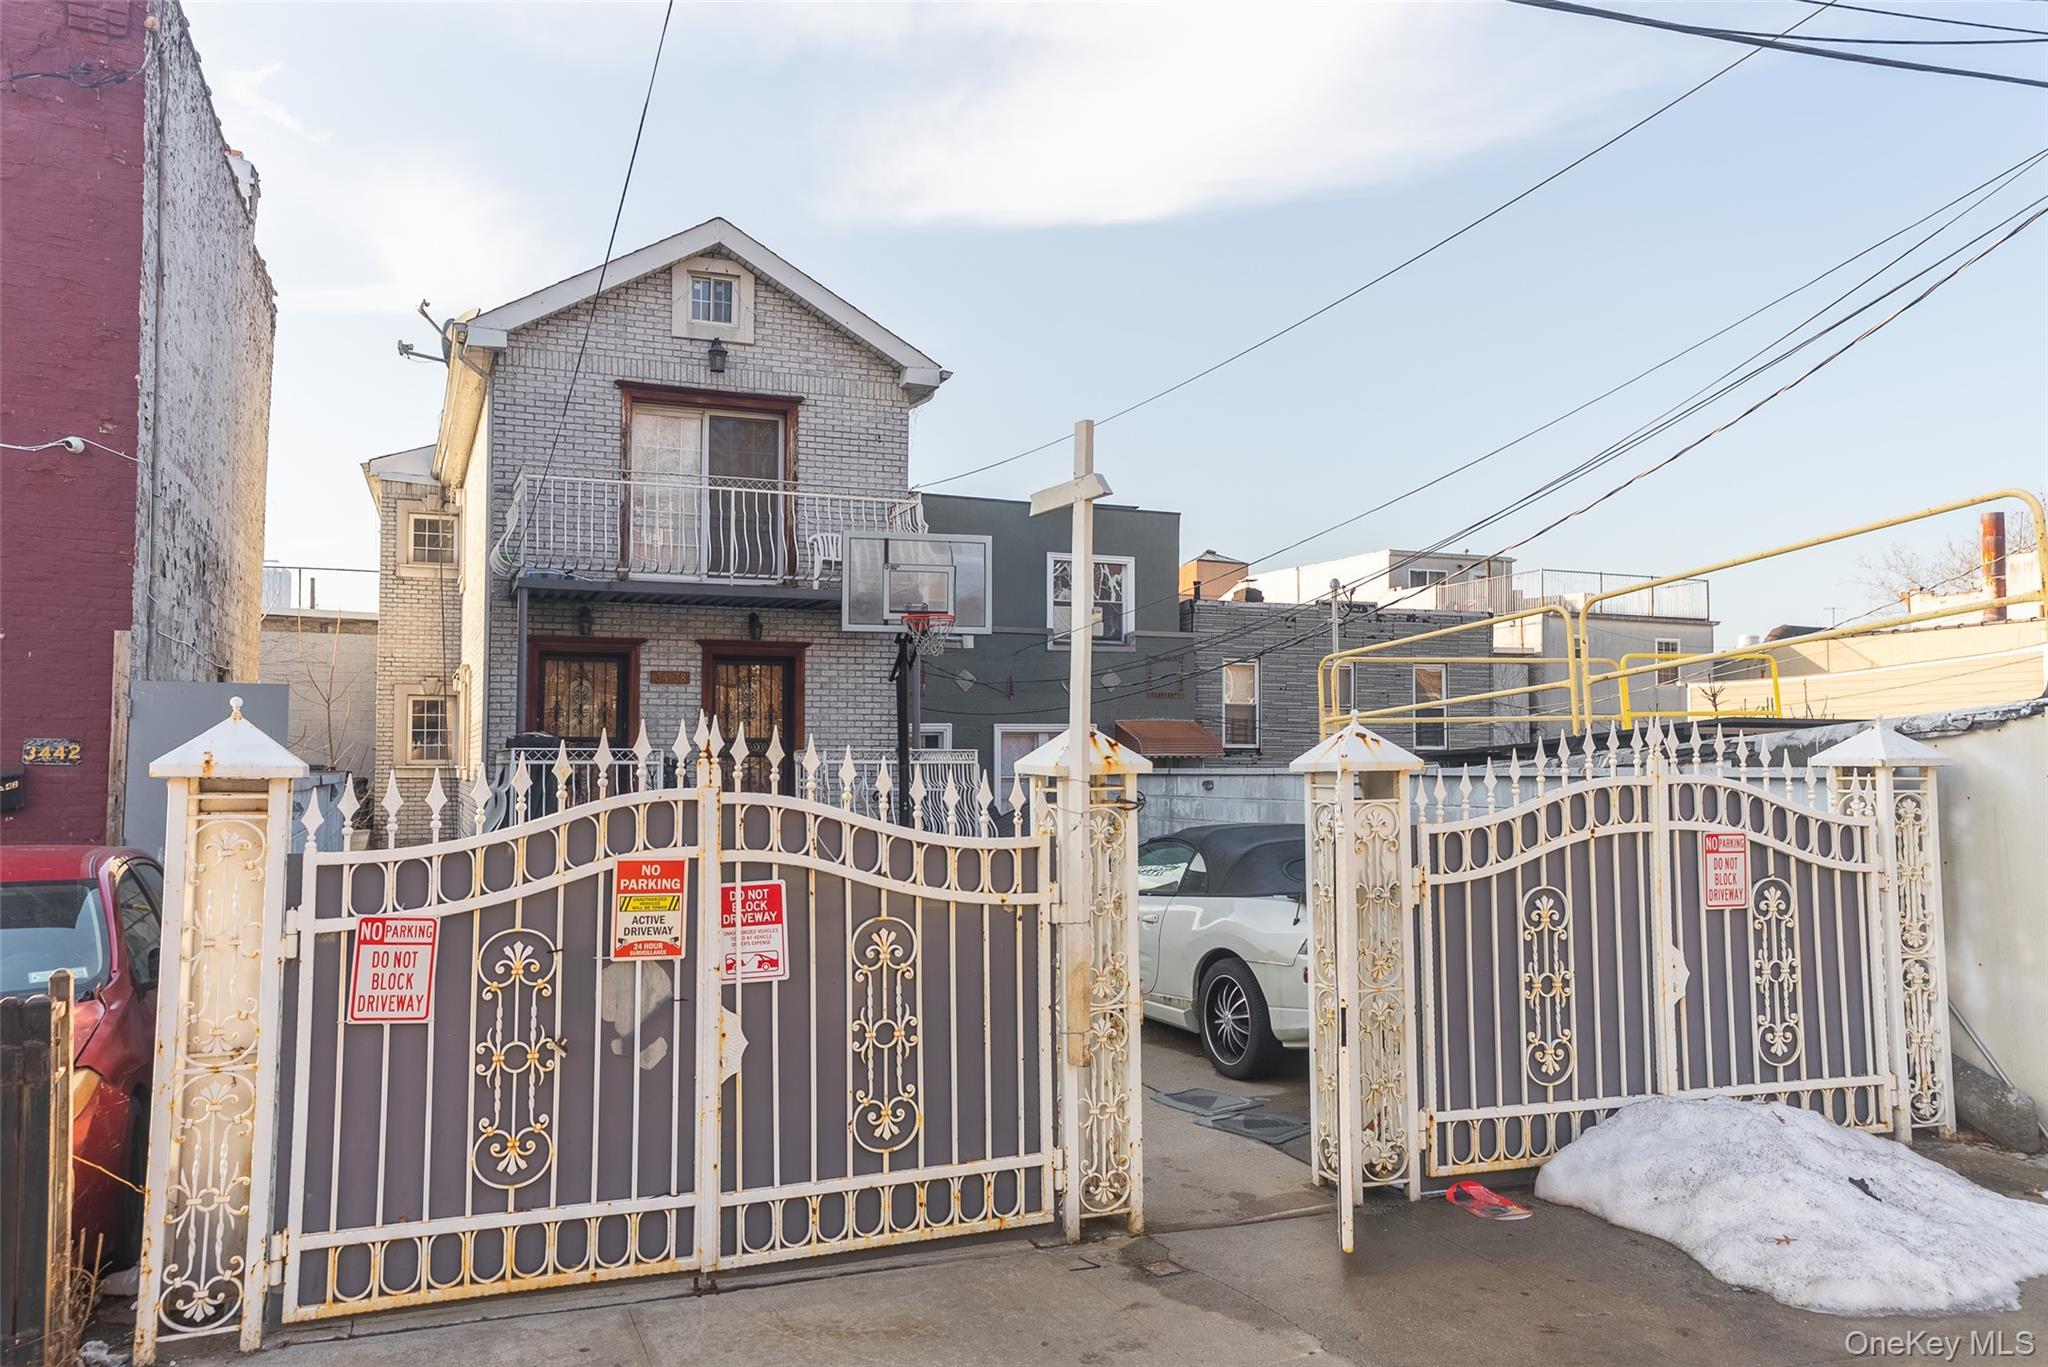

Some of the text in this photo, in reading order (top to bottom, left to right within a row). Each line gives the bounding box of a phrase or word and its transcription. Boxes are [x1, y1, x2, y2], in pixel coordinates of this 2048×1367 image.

[24, 744, 81, 760] 3442
[1705, 837, 1744, 851] NO PARKING
[641, 864, 661, 876] NO
[1713, 857, 1738, 870] DO NOT
[620, 878, 680, 890] PARKING
[1714, 873, 1737, 886] BLOCK
[748, 889, 769, 900] NOT
[1708, 888, 1743, 901] DRIVEWAY
[632, 915, 666, 925] ACTIVE
[723, 911, 778, 925] DRVEWAY
[361, 922, 433, 941] NO PARKING
[624, 926, 674, 936] DRIVEWAY
[643, 942, 664, 950] HOUR
[372, 951, 418, 968] DO NOT
[371, 973, 414, 990] BLOCK
[357, 994, 424, 1012] DRIVEWAY
